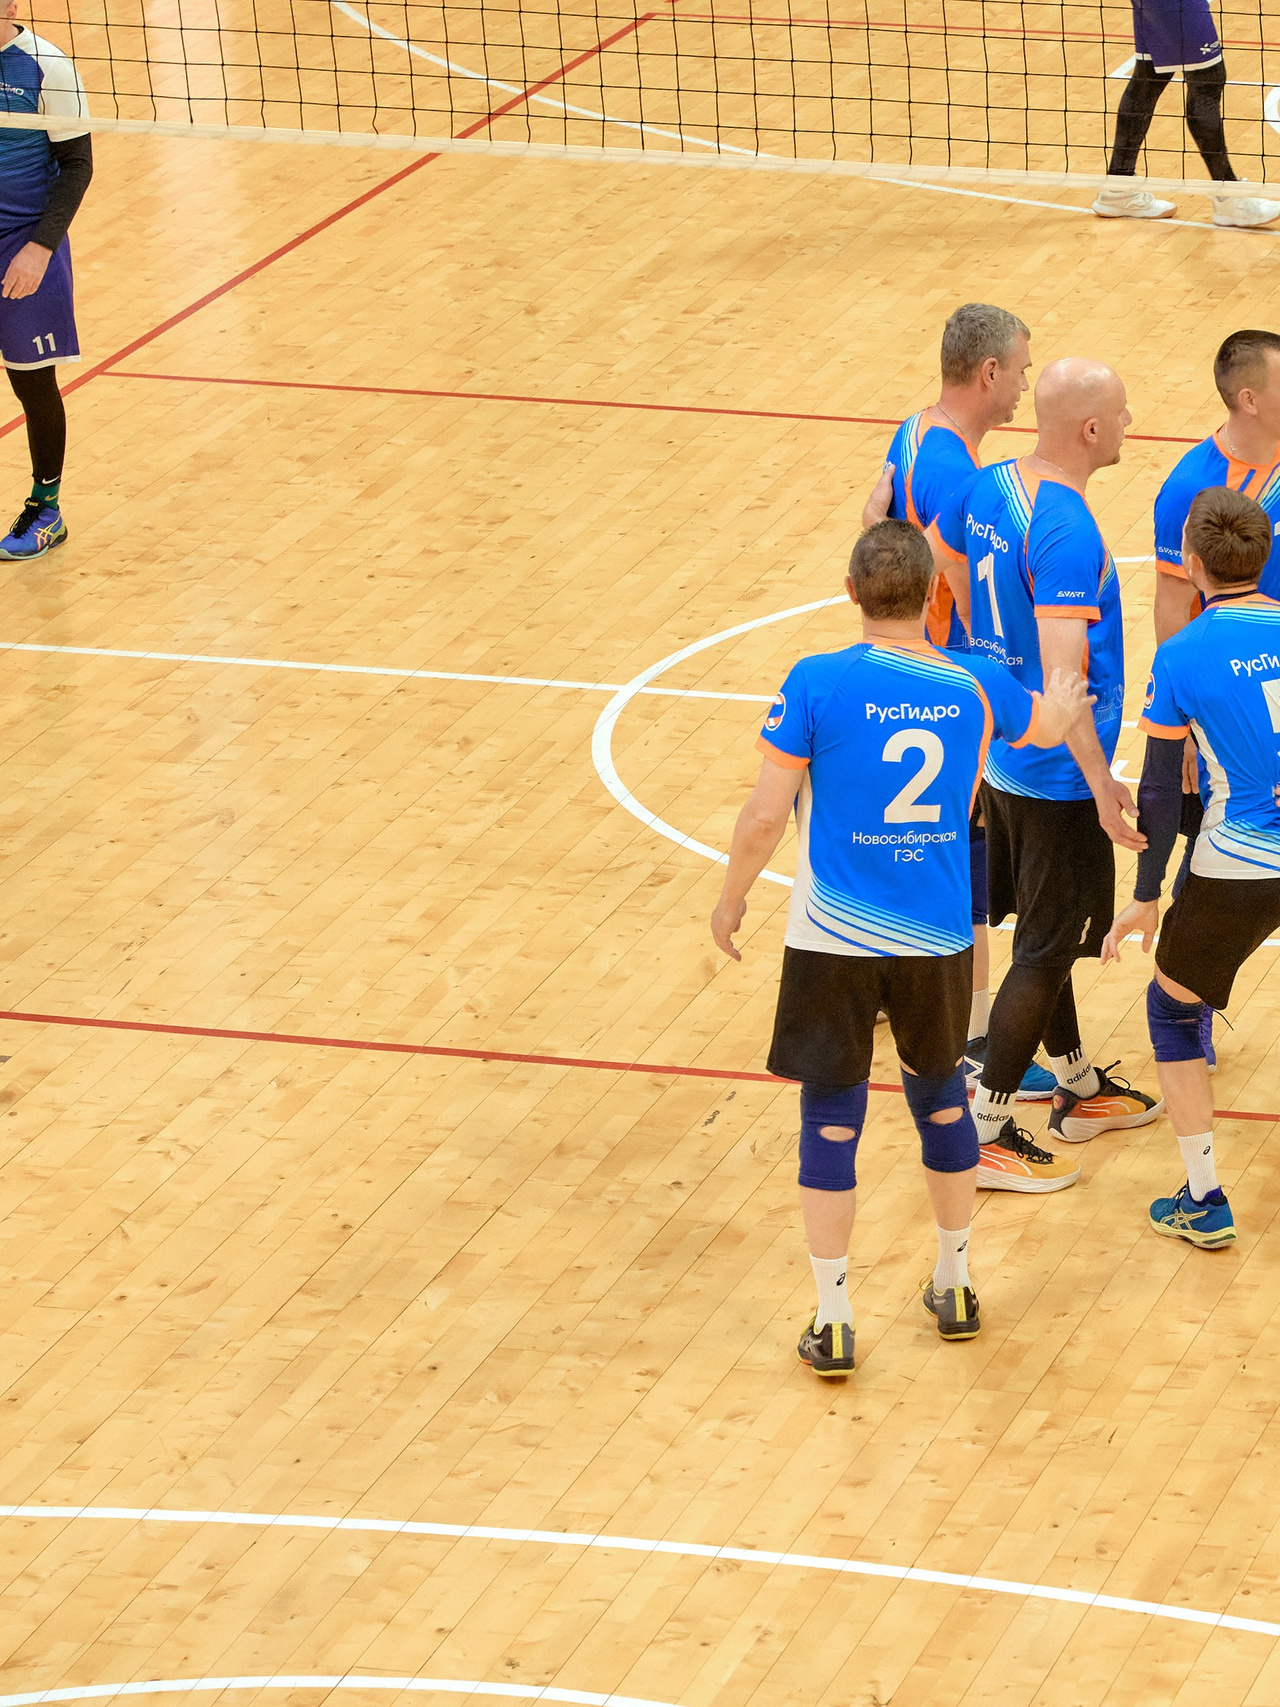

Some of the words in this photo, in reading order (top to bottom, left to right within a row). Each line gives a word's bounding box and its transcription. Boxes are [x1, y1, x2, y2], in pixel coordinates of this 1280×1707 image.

[32, 332, 56, 355] 11
[977, 552, 1004, 639] 1
[1056, 590, 1086, 598] SVART
[865, 703, 960, 724] РусГидро
[882, 728, 944, 823] 2
[852, 830, 957, 846] Новосибирская
[894, 849, 924, 862] ГЭС
[976, 1112, 1009, 1122] adidas
